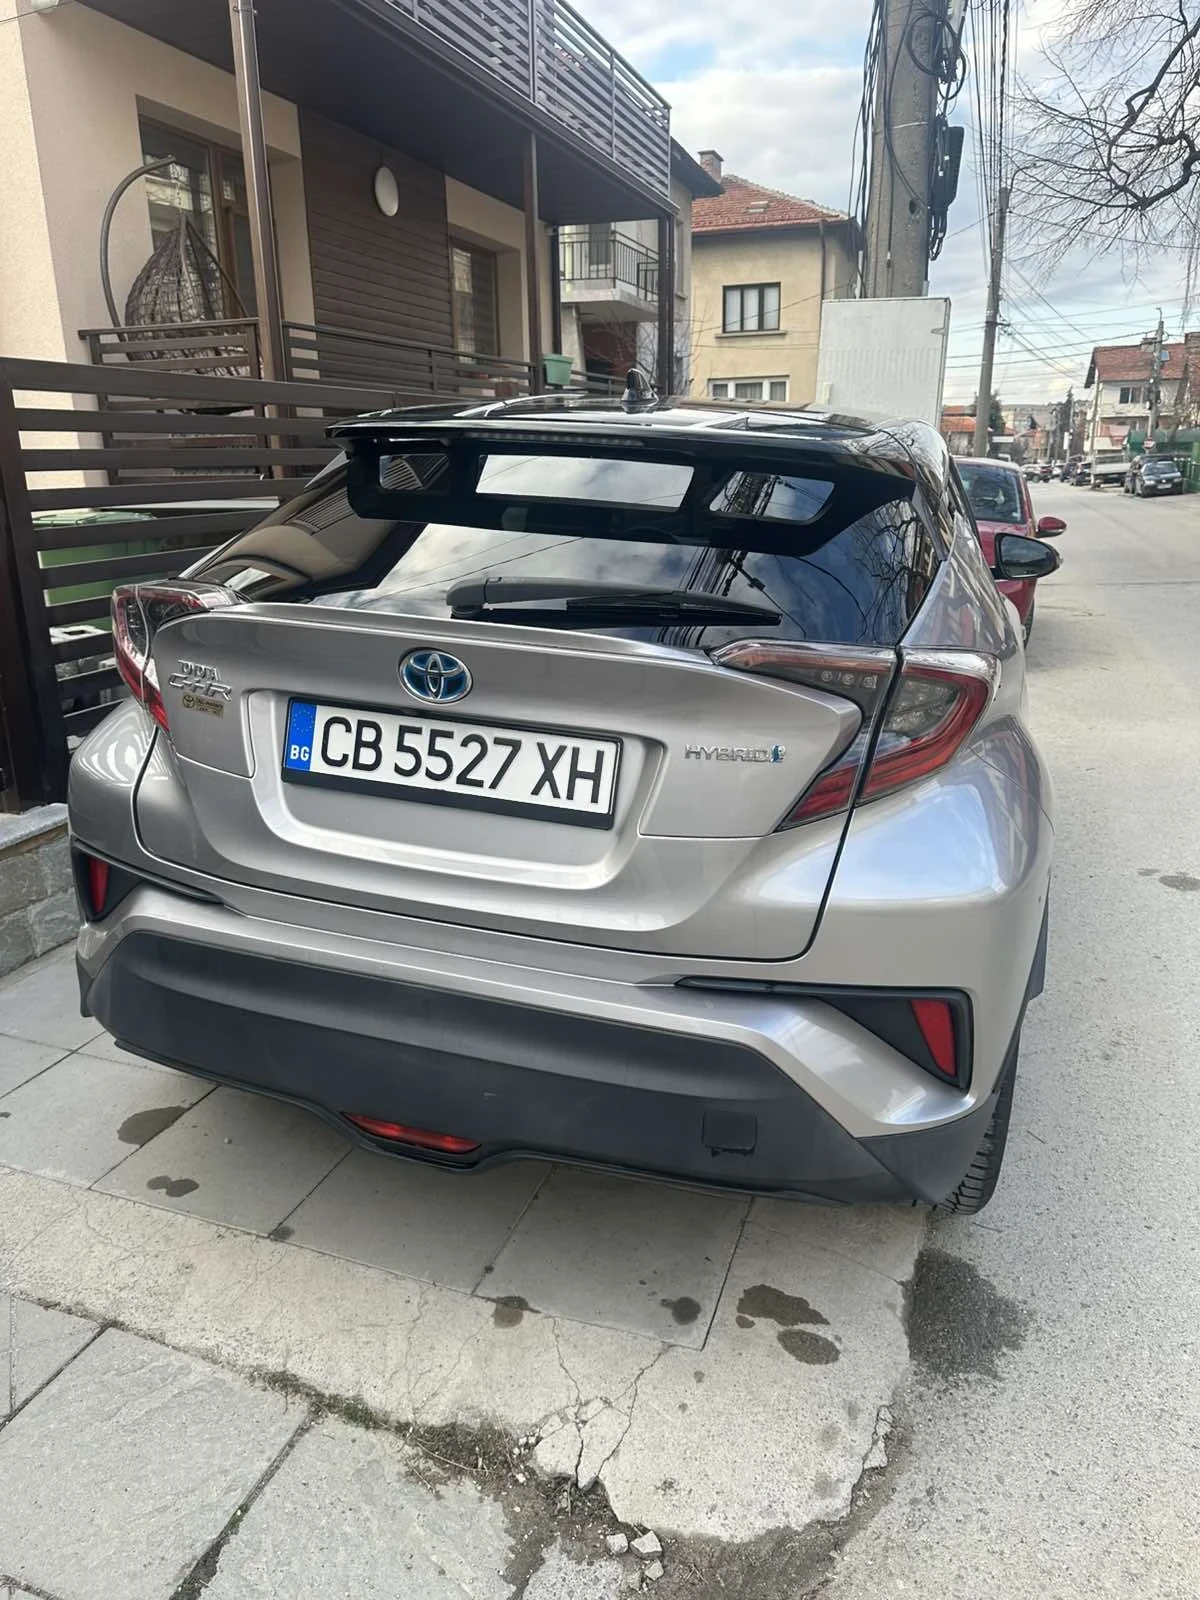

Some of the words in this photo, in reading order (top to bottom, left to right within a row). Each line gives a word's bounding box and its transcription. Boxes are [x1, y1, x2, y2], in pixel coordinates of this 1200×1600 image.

[289, 745, 310, 761] BG
[320, 716, 383, 772] CB
[393, 724, 522, 790] 5527
[530, 741, 605, 804] XH
[684, 744, 770, 763] HYBRID
